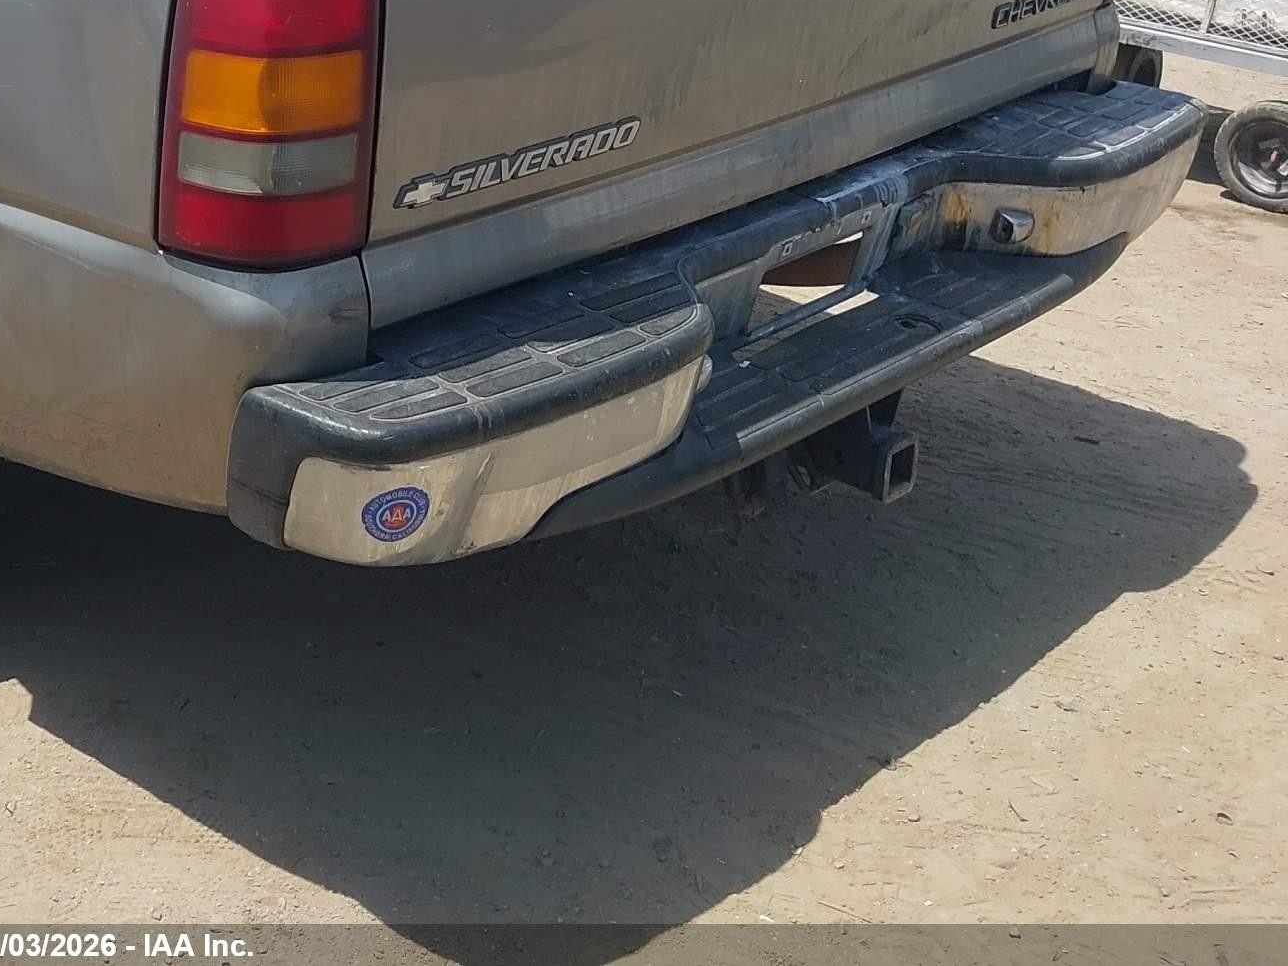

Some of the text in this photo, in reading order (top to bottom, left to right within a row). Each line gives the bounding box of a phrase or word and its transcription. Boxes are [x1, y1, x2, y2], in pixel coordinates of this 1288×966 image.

[445, 117, 642, 198] SILVERADO
[369, 489, 413, 512] AUTOMOBILE
[381, 507, 413, 524] AAA
